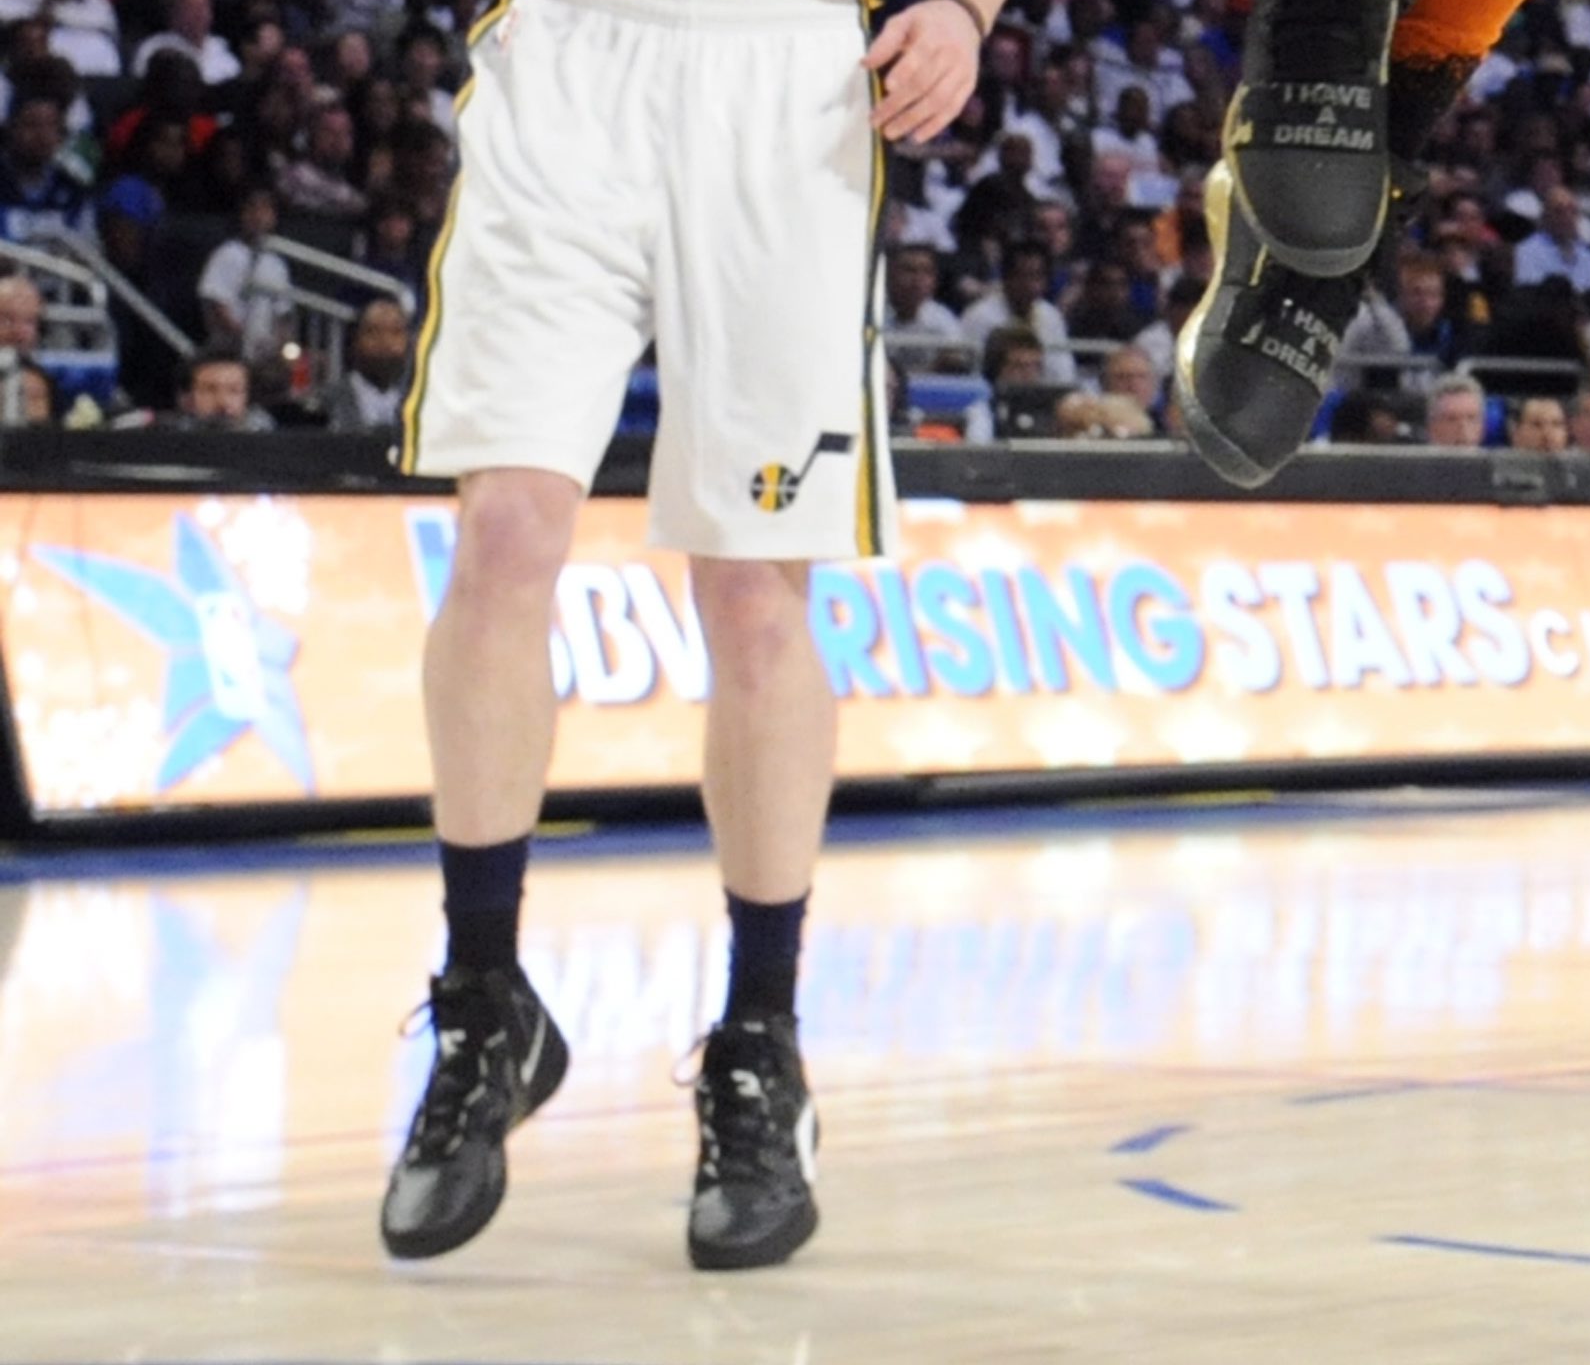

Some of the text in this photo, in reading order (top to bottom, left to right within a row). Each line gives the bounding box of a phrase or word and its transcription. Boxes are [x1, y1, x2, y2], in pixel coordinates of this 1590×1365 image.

[1299, 82, 1372, 108] HAVE
[1316, 106, 1337, 125] A
[1274, 124, 1374, 150] DREAM
[807, 562, 1206, 697] RISING
[1200, 558, 1534, 694] STARS
